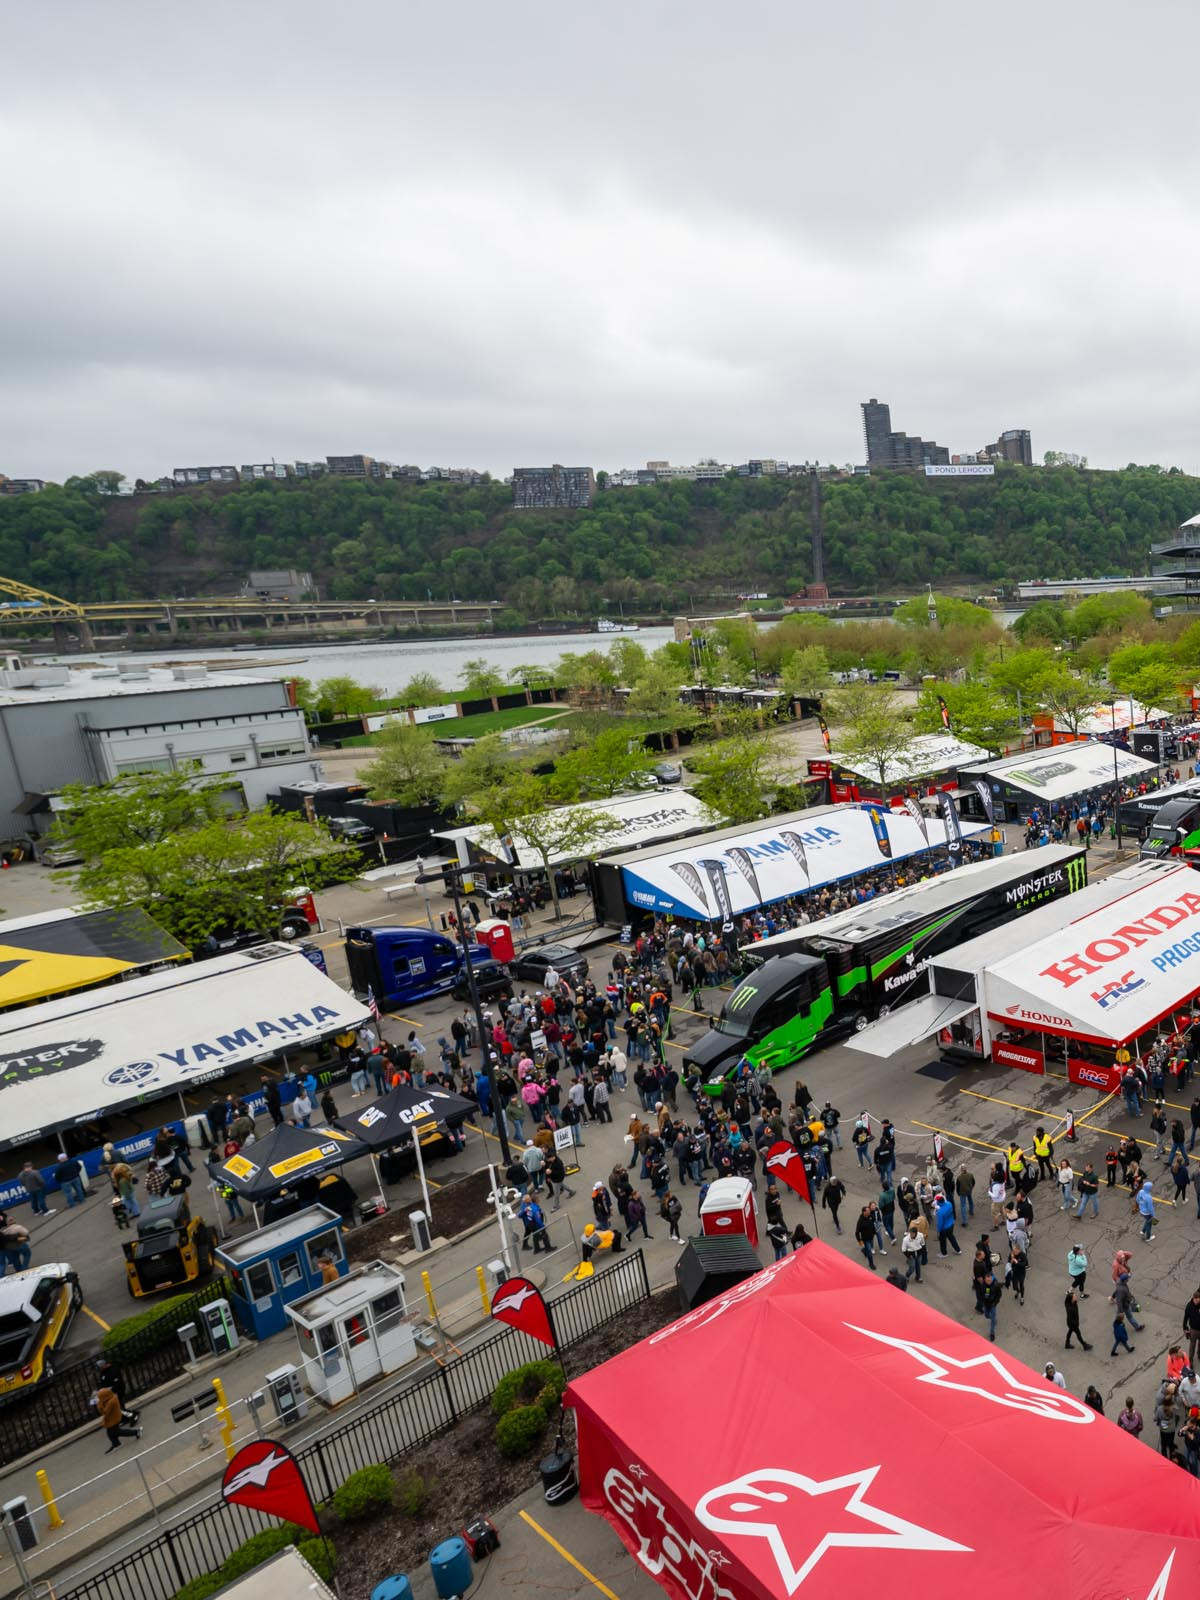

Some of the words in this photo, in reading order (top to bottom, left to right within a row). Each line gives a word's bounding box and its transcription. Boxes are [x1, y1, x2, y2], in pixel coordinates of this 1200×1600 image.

[935, 466, 957, 475] POND
[958, 466, 993, 475] LEHOCKY
[1138, 802, 1163, 811] Kawasa
[1006, 869, 1064, 903] MONSTER
[1016, 887, 1057, 909] ENERGY
[884, 954, 932, 992] Kawaak
[1090, 970, 1146, 1009] HRC
[1020, 1009, 1074, 1028] HONDA
[158, 1005, 340, 1066] YAMAHA
[138, 1022, 335, 1088] RACING
[998, 1049, 1037, 1066] PROGRESSIVE
[1078, 1067, 1109, 1086] HRC
[358, 1106, 387, 1127] CAT
[399, 1099, 434, 1124] CAT
[119, 1137, 153, 1155] ALUBE
[0, 1185, 29, 1201] MAH
